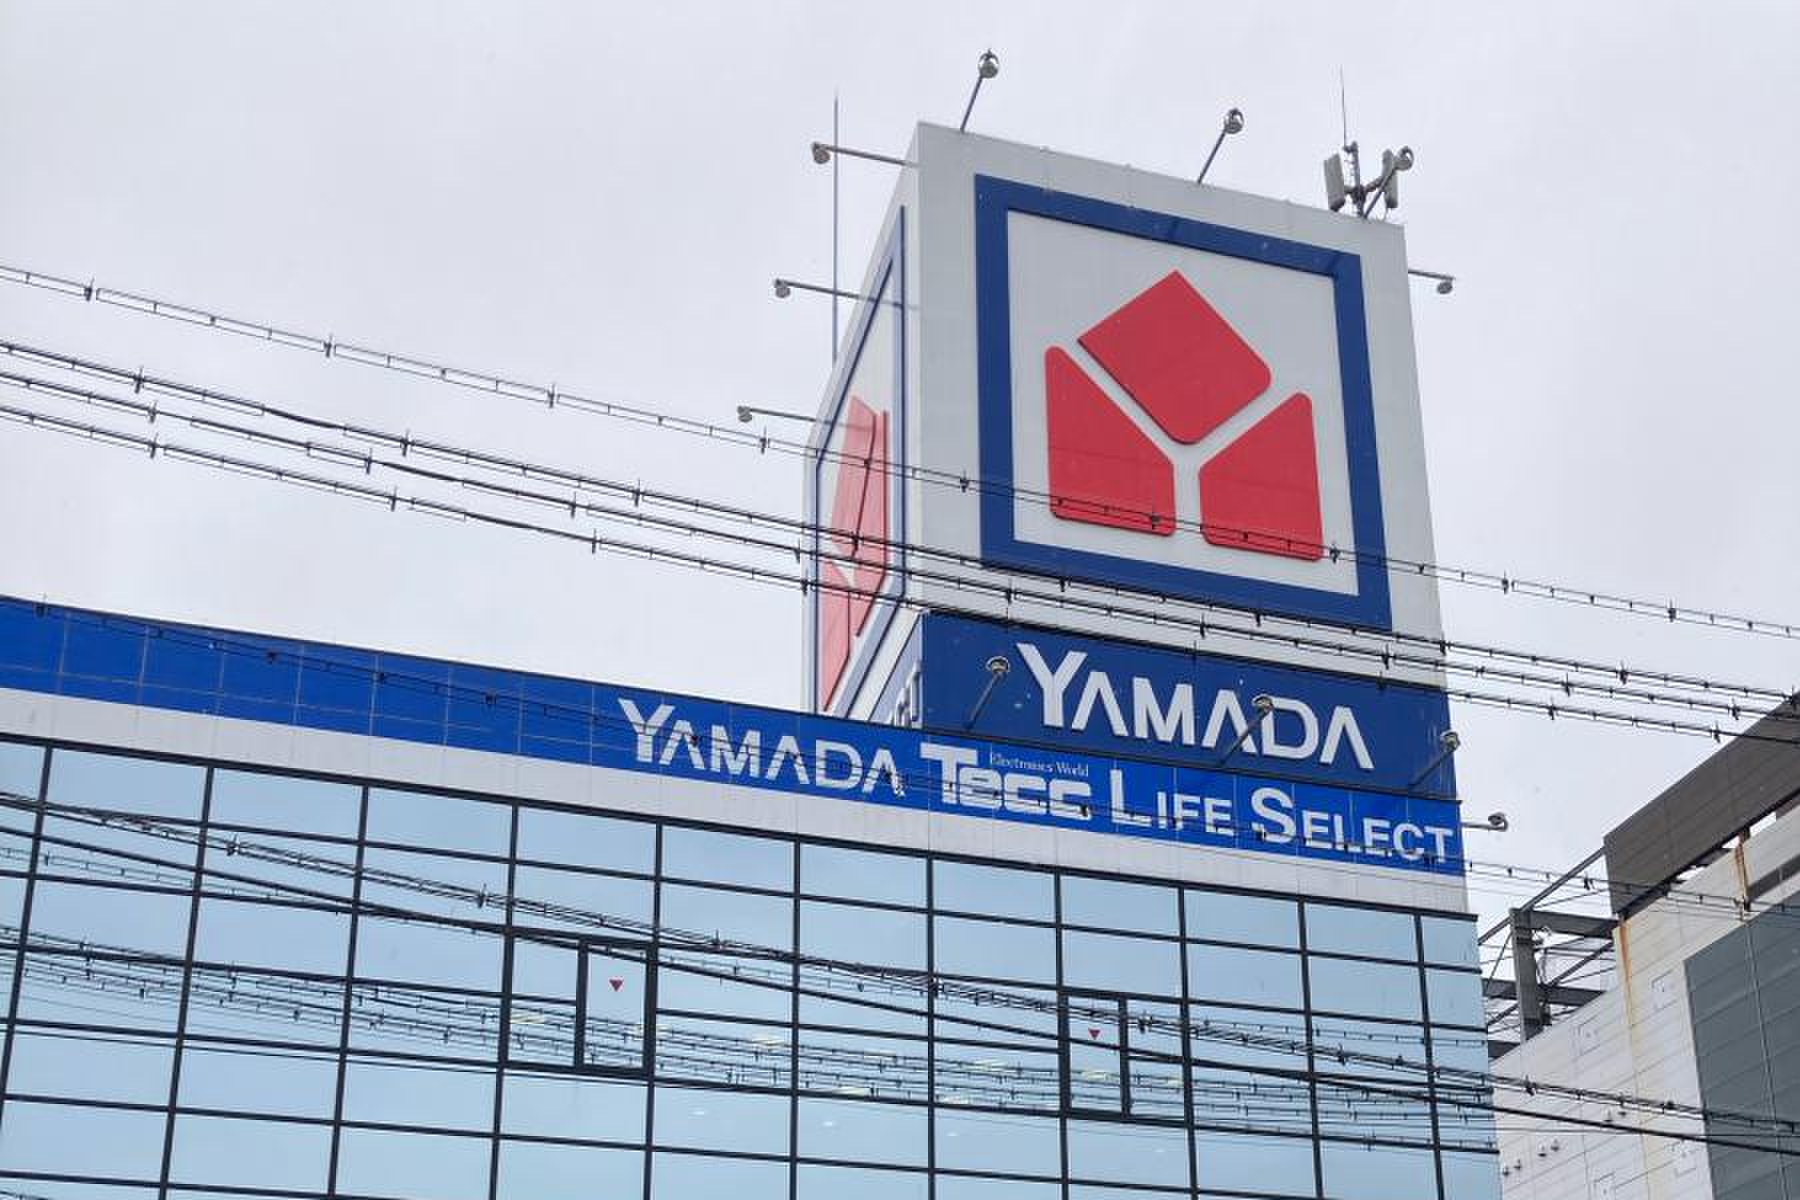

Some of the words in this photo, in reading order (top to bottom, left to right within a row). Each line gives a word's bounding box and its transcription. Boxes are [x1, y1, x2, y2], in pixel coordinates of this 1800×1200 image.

[989, 751, 1054, 774] Electronics
[1055, 761, 1090, 777] World
[1016, 643, 1375, 770] YAMADA
[618, 697, 906, 797] YAMADA
[920, 742, 1092, 821] Tecc
[1110, 768, 1235, 836] LIFE
[1250, 787, 1454, 865] SELECT
